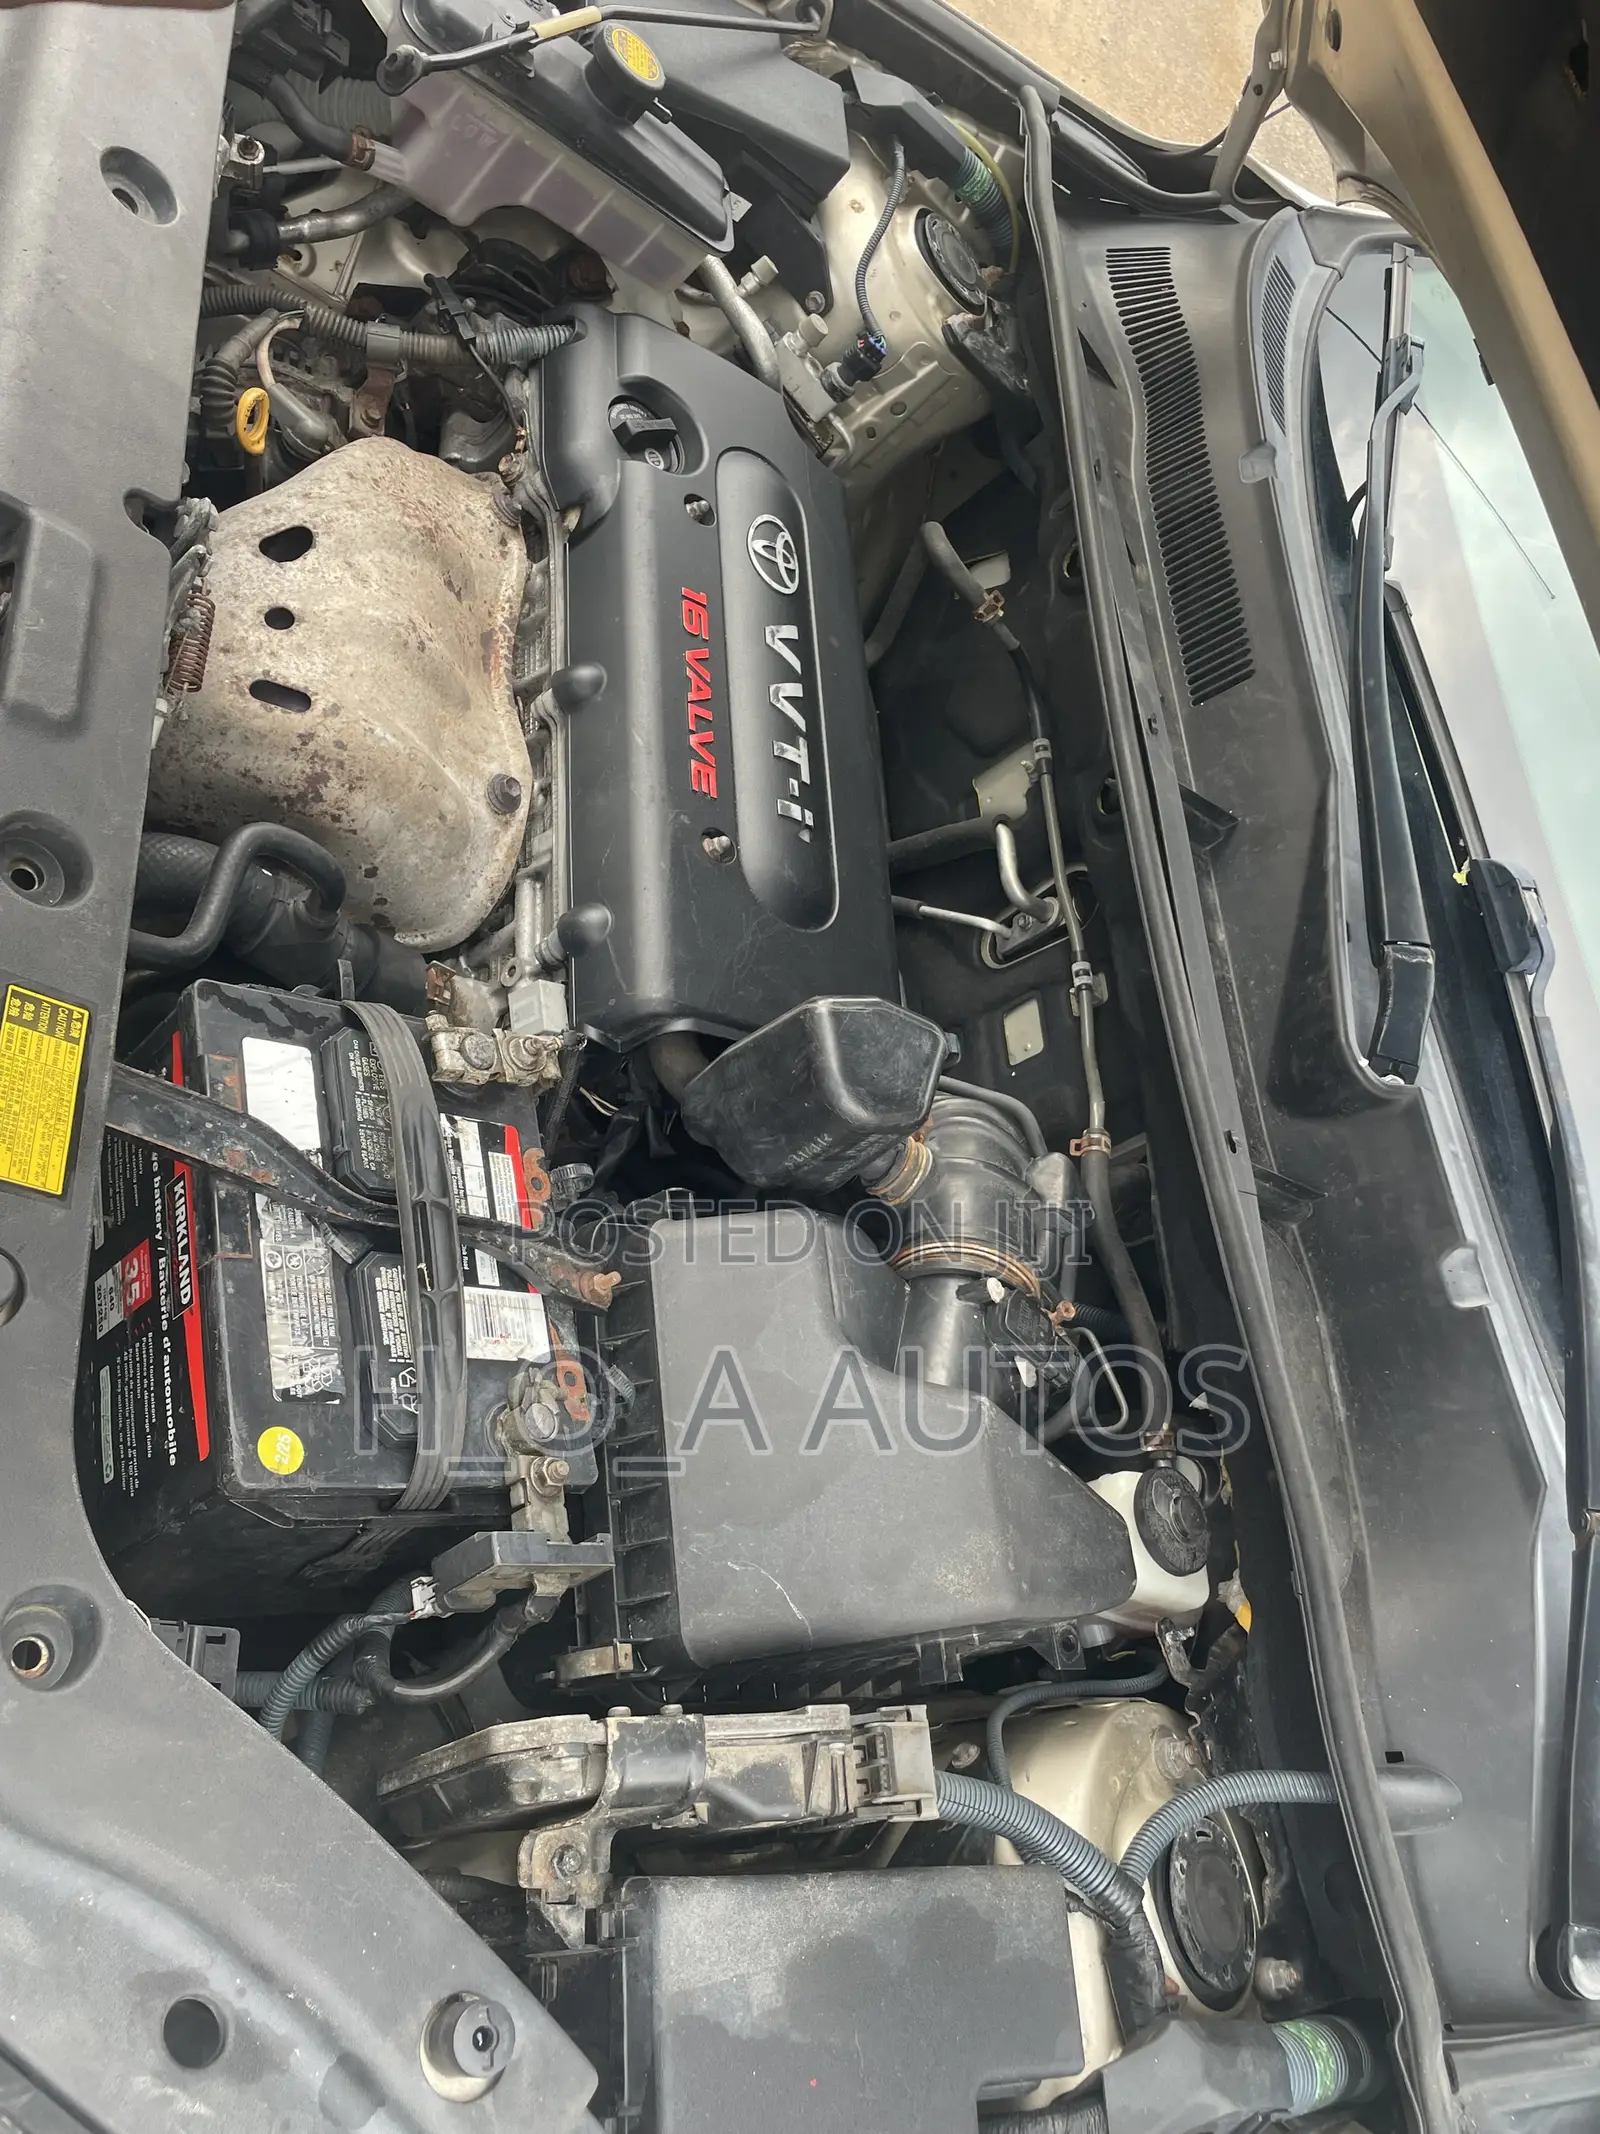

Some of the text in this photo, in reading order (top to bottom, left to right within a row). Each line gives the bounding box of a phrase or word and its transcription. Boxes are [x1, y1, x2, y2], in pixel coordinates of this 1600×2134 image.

[682, 586, 718, 800] 16 VALVE
[764, 624, 814, 829] VVT-i
[37, 1001, 51, 1034] ATTENTION
[55, 1007, 69, 1040] CAUTION
[362, 1057, 370, 1077] GASES
[451, 1176, 460, 1194] Canada
[456, 1166, 464, 1189] Imported
[152, 1176, 164, 1240] battery
[174, 1180, 192, 1305] KIRKLAND
[125, 1257, 140, 1306] 35
[157, 1256, 170, 1331] Batterie
[399, 1333, 410, 1358] STARTING
[143, 1378, 149, 1388] de
[162, 1336, 178, 1467] d'automobile
[143, 1390, 151, 1432] démarrage
[134, 1478, 139, 1489] de
